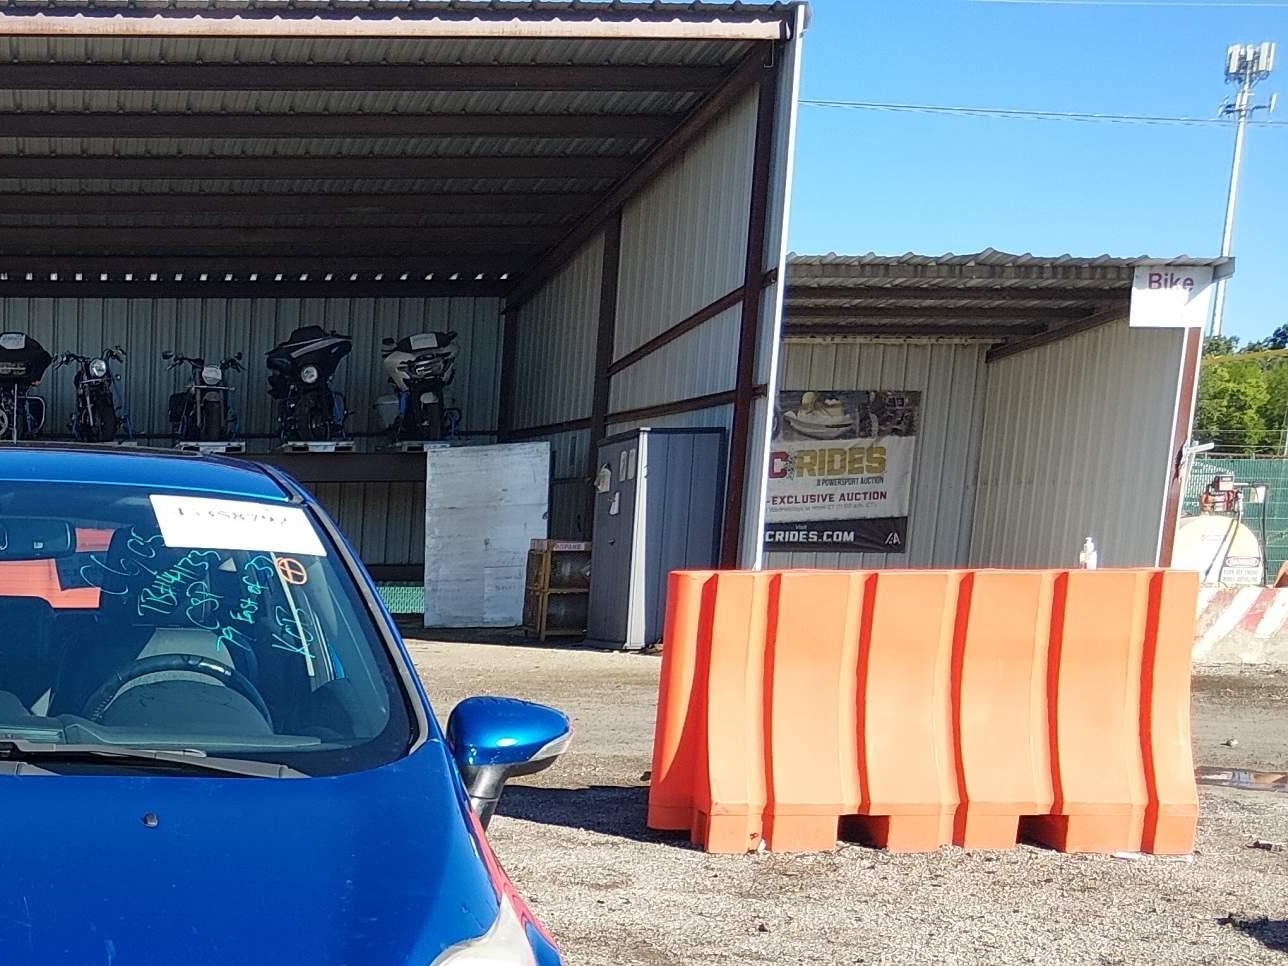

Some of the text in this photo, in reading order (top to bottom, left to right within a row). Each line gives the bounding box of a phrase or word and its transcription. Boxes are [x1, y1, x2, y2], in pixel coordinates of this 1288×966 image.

[1148, 272, 1195, 290] Bike
[796, 446, 887, 478] RIDES
[839, 490, 888, 502] AUCTION
